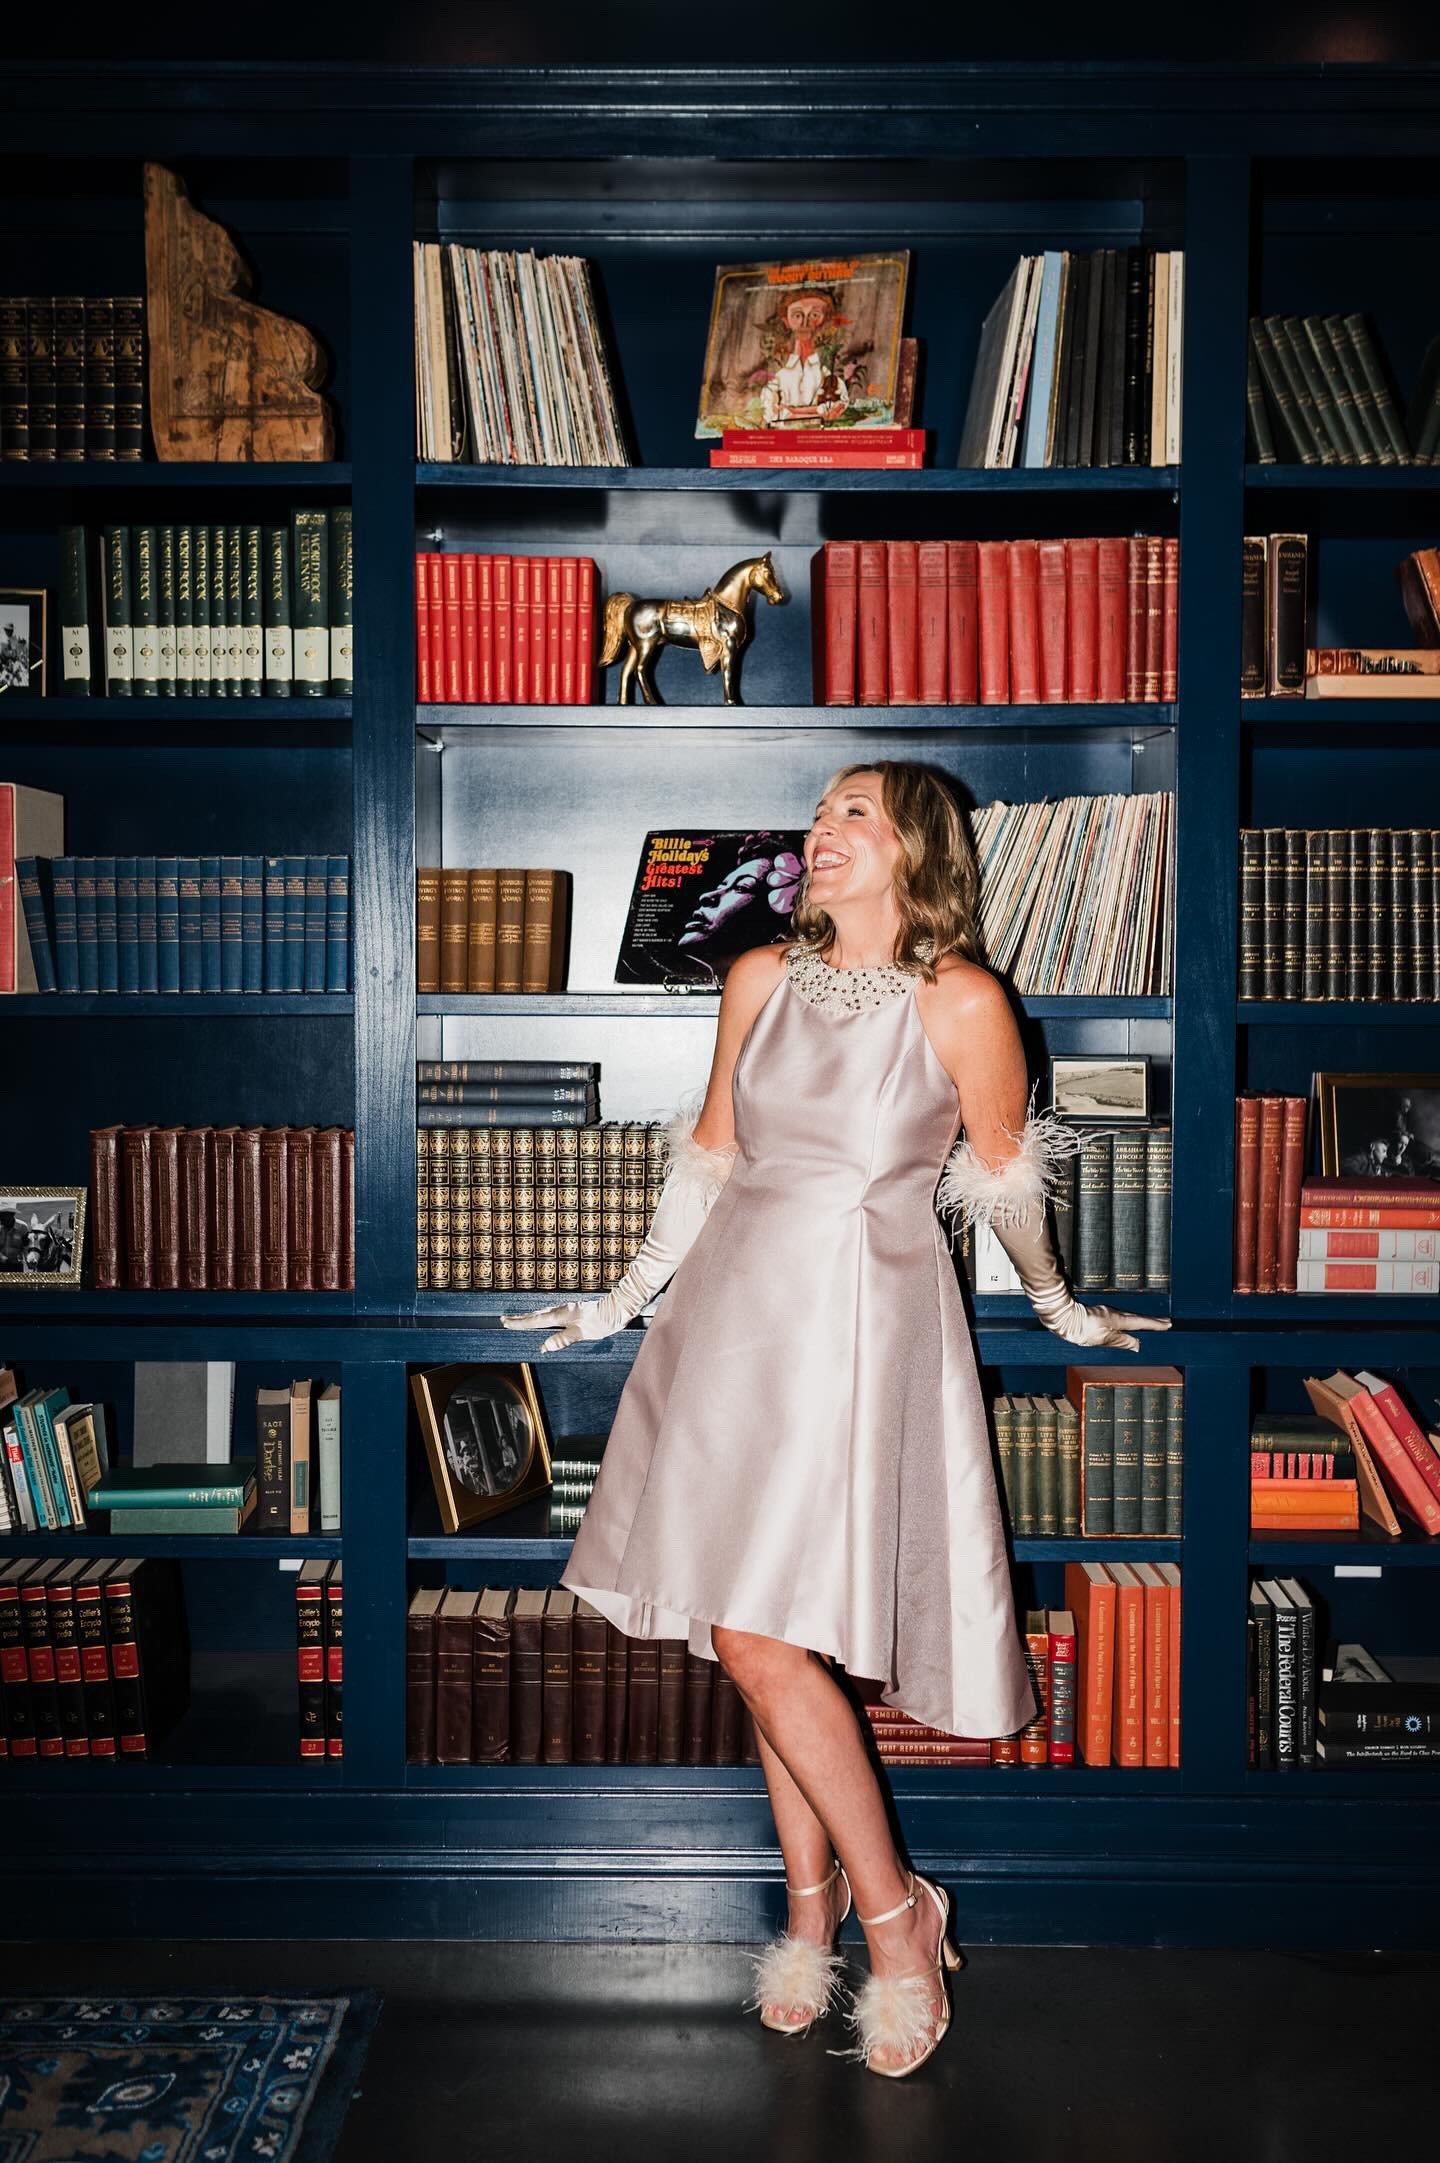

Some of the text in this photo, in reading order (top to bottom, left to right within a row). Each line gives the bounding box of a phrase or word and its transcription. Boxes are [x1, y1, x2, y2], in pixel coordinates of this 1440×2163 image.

[651, 838, 691, 850] Billie
[648, 848, 710, 865] Holiday's
[646, 863, 704, 875] Greatest
[641, 876, 682, 890] Hits!
[12, 1447, 20, 1462] TIME
[299, 1608, 320, 1617] Collier's
[1302, 1612, 1313, 1639] What
[1278, 1623, 1297, 1753] The Federal Courts
[875, 1711, 899, 1719] SMOOT
